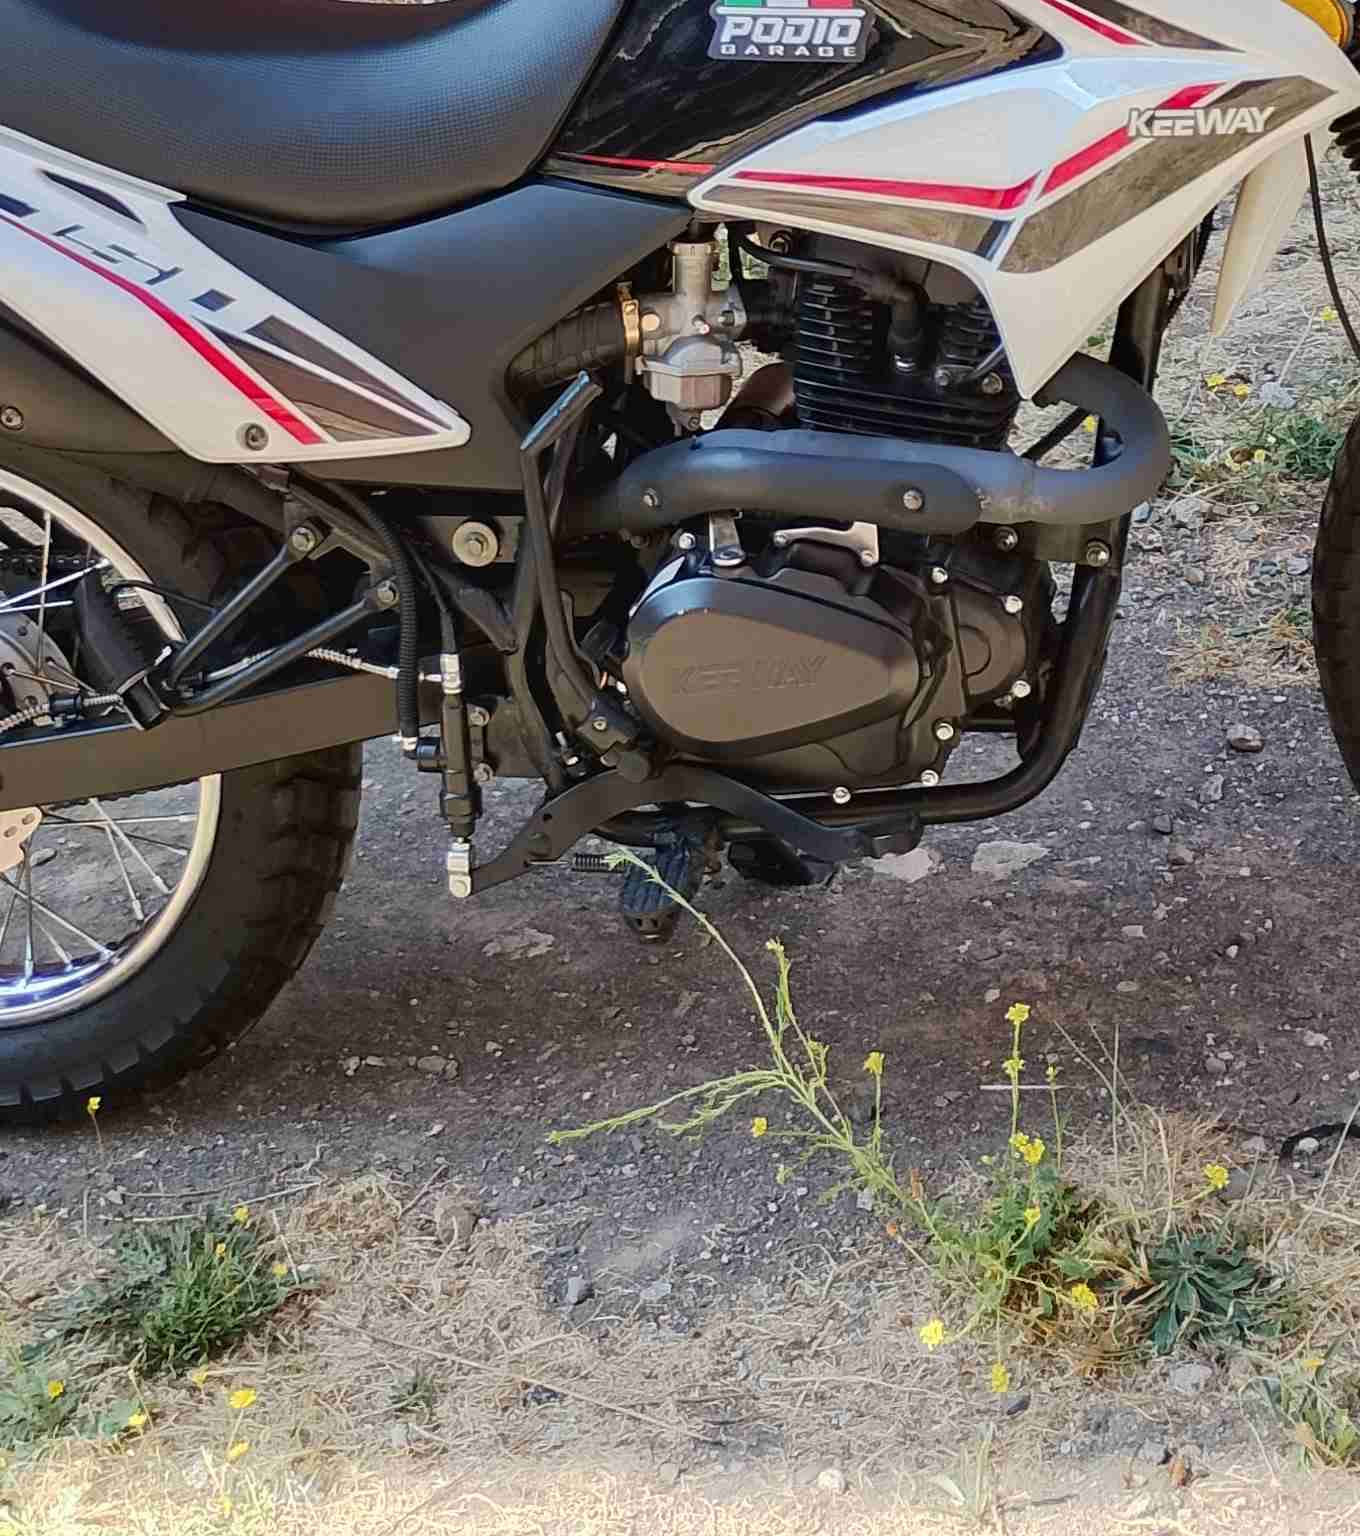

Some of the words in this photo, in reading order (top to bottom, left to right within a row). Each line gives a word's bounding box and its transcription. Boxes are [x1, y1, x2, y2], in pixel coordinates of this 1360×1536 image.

[720, 16, 862, 45] PODIO
[720, 44, 857, 57] GARAGE
[1127, 107, 1275, 138] KEEWAY
